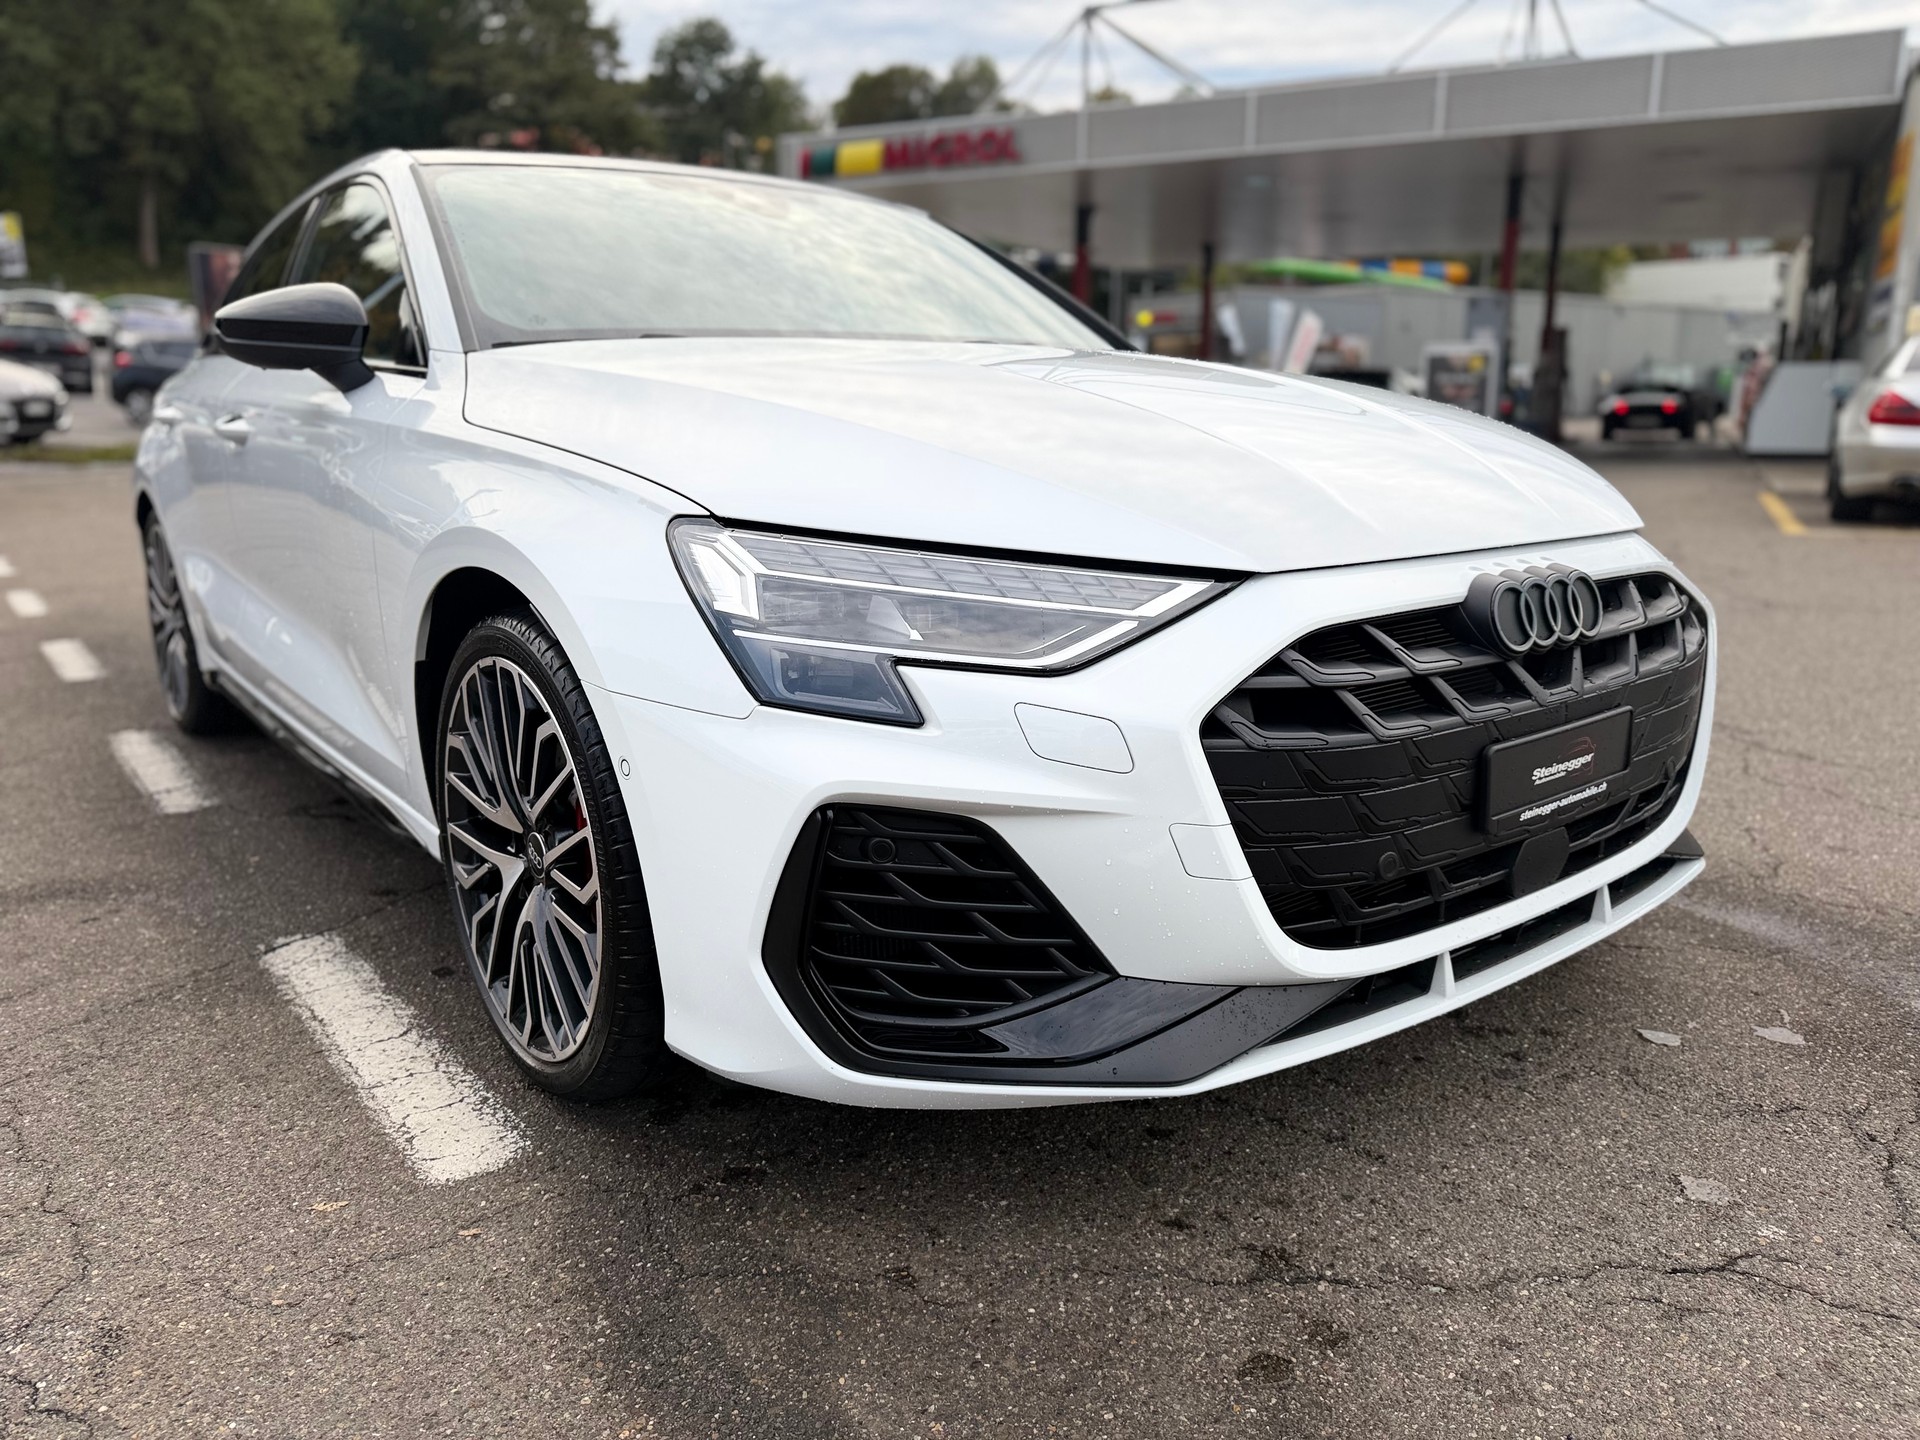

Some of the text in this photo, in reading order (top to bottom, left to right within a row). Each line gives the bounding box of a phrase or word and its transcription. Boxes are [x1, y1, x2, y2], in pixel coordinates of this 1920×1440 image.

[885, 126, 1020, 170] MIGROL
[1531, 752, 1595, 780] Steinegger
[1519, 781, 1608, 822] steinegger-automobile.ch
